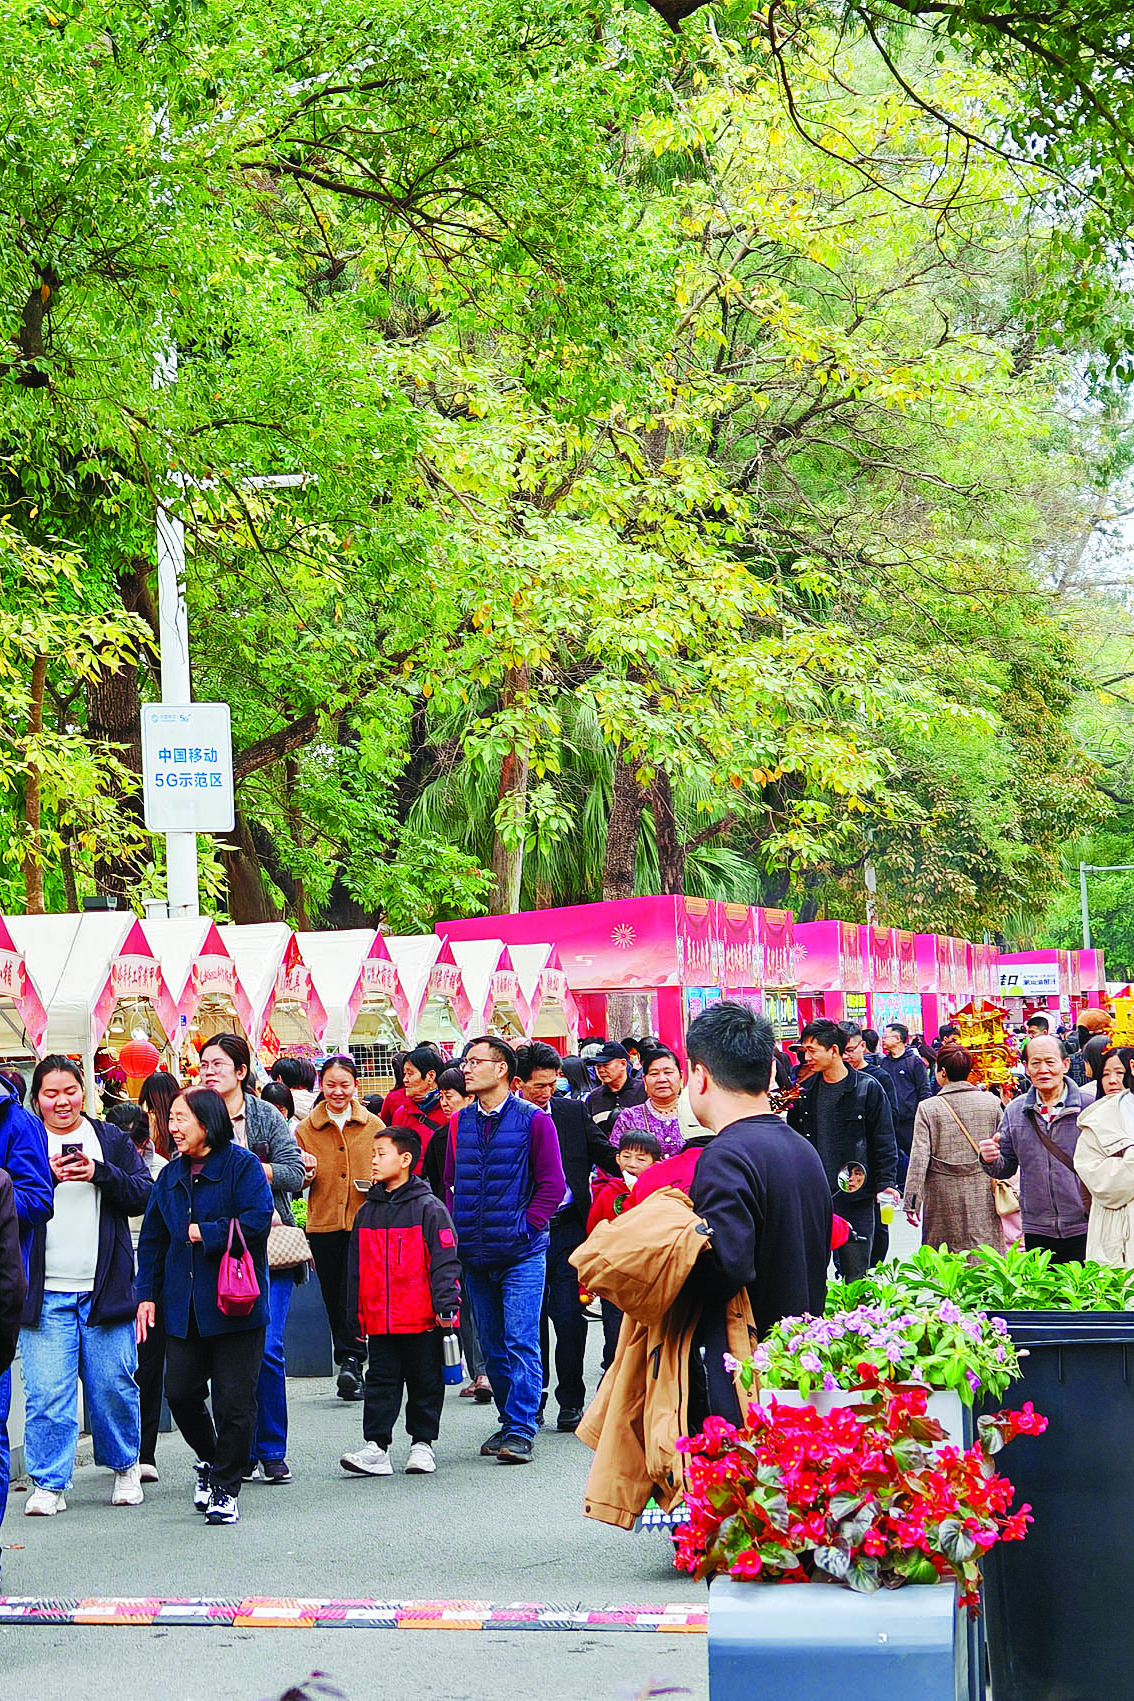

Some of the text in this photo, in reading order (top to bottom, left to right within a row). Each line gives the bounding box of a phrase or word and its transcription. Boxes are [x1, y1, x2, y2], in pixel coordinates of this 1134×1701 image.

[158, 747, 218, 764] 中国移动
[155, 772, 223, 788] 5G示范区
